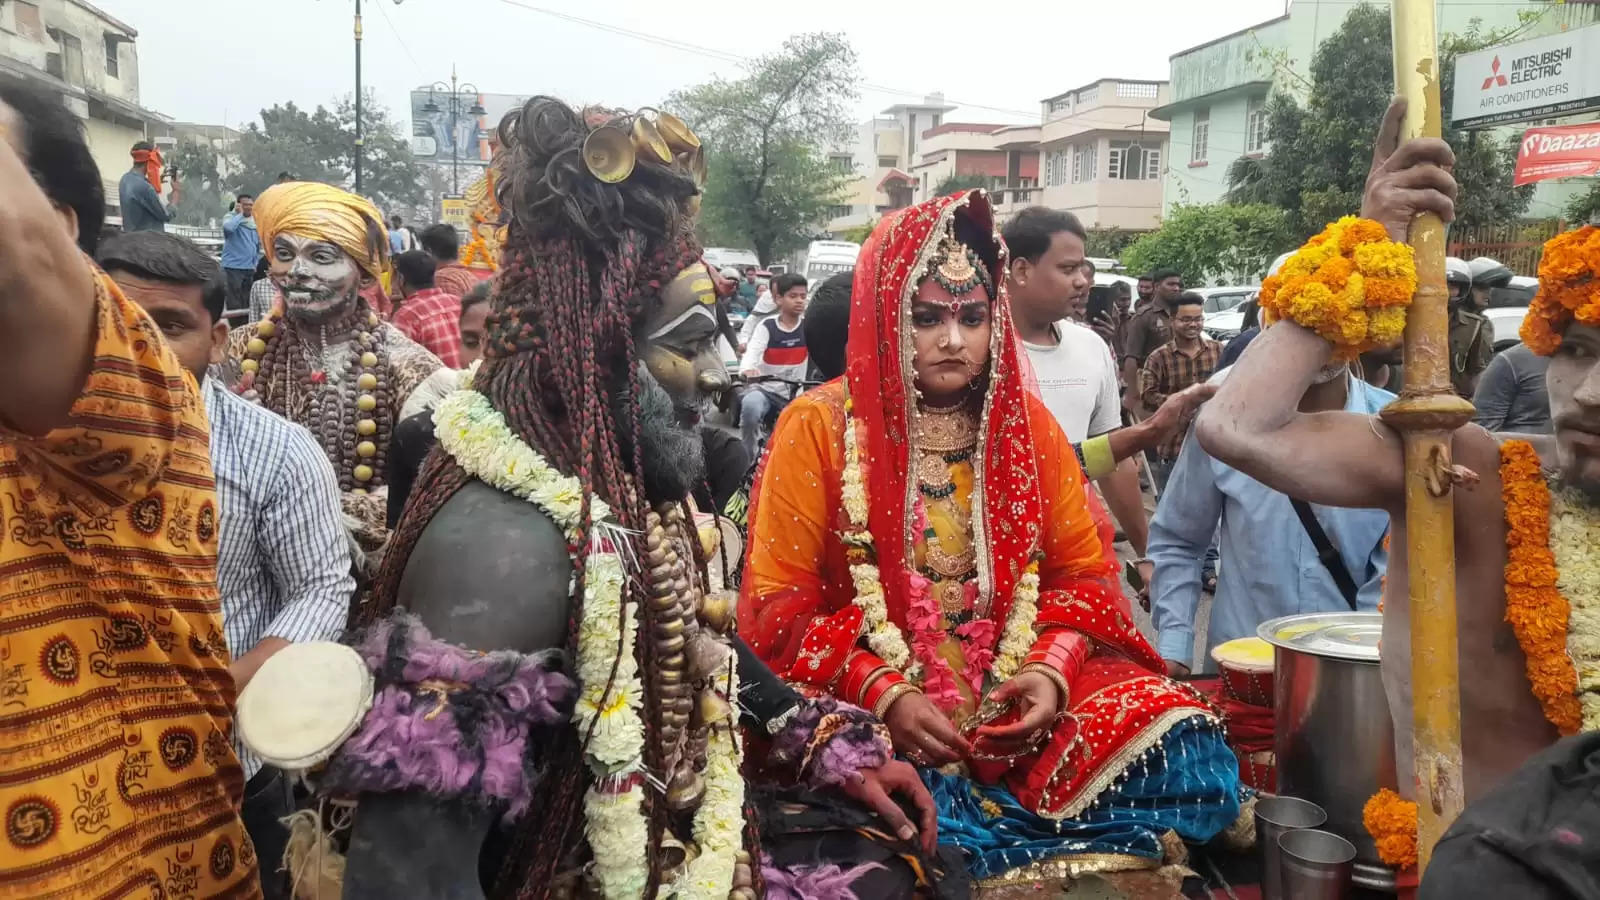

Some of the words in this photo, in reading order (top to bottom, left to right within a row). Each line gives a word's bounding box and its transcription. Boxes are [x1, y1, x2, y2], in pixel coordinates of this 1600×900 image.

[1511, 46, 1572, 72] MITSUBISHI
[1510, 62, 1562, 85] ELECTRIC
[1480, 96, 1495, 109] AIR
[1496, 82, 1569, 106] CONDITIONERS
